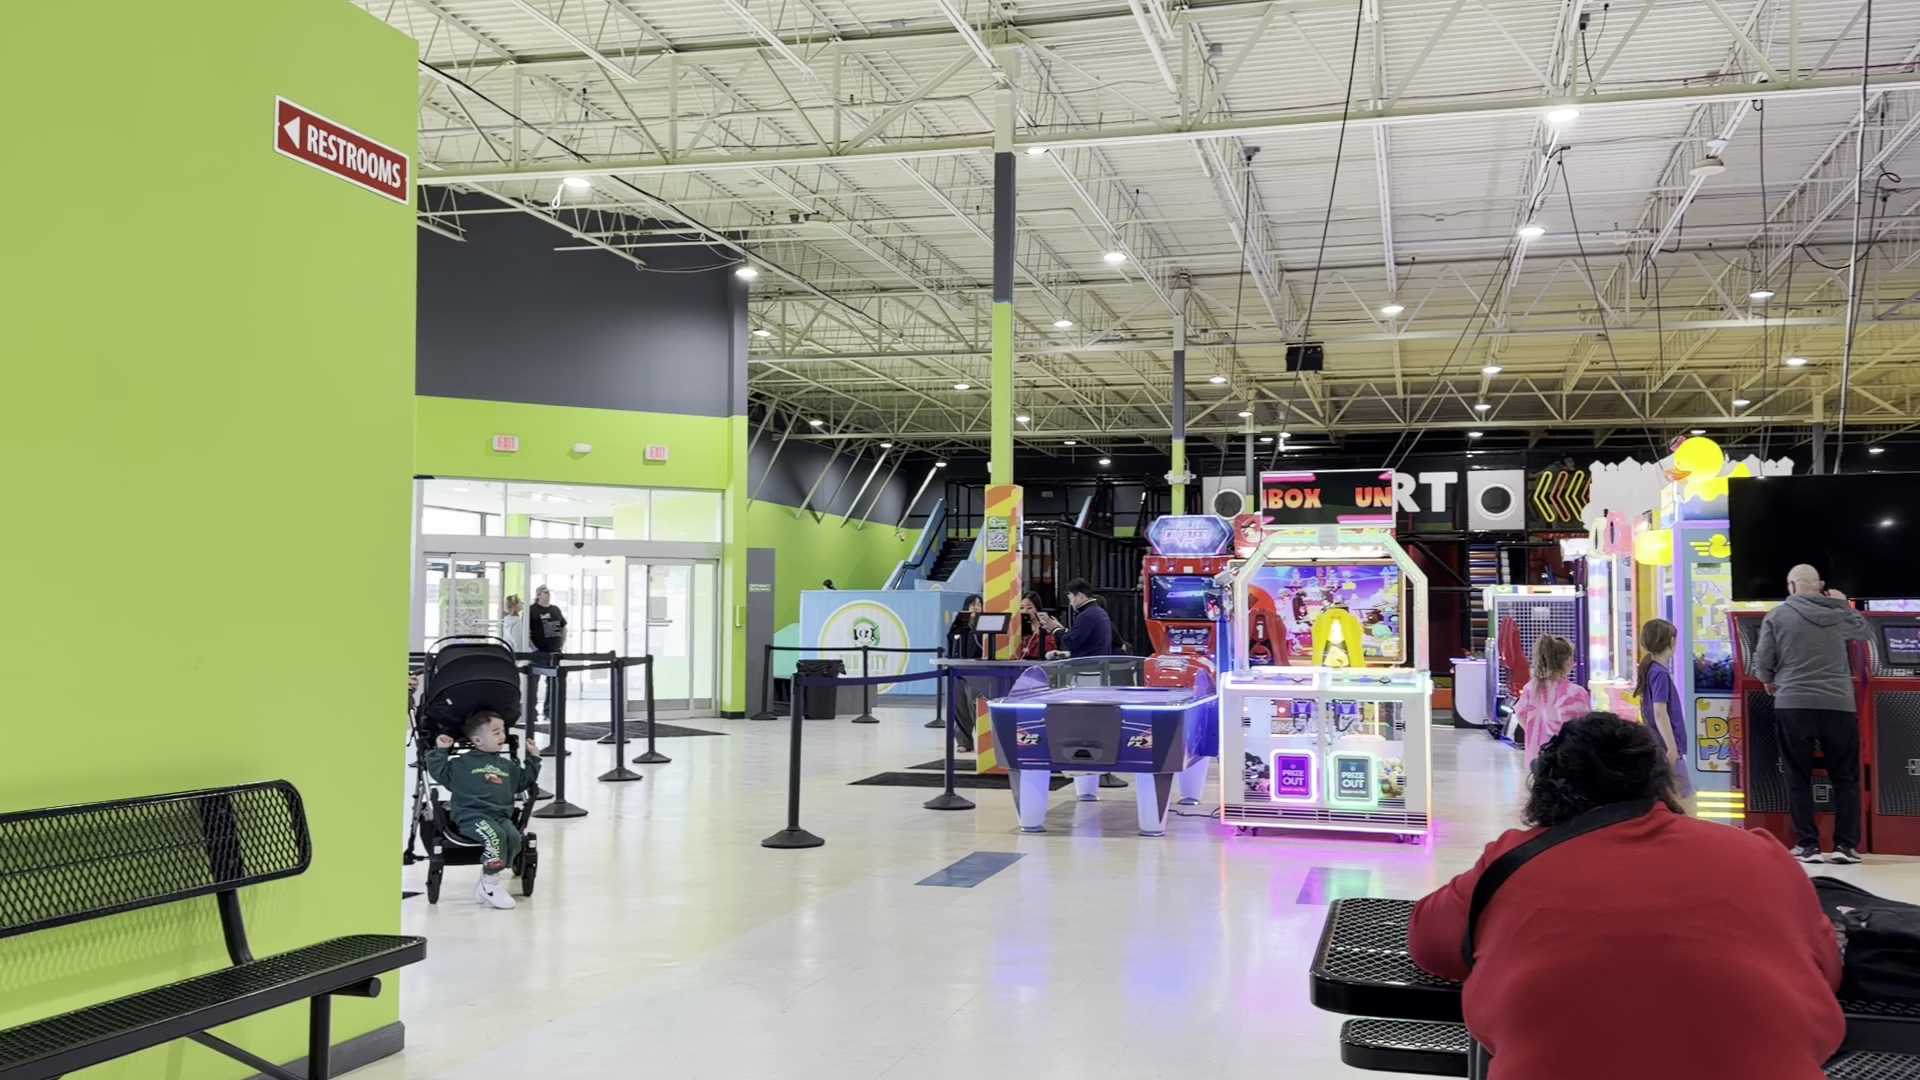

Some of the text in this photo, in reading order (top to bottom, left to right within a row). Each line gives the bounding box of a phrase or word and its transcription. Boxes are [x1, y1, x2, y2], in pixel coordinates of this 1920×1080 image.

[306, 124, 401, 189] RESTROOMS
[497, 436, 515, 450] EXIT
[649, 446, 666, 459] EXIT
[1354, 486, 1392, 508] UN
[1282, 777, 1305, 786] OUT
[1341, 780, 1365, 789] OUT
